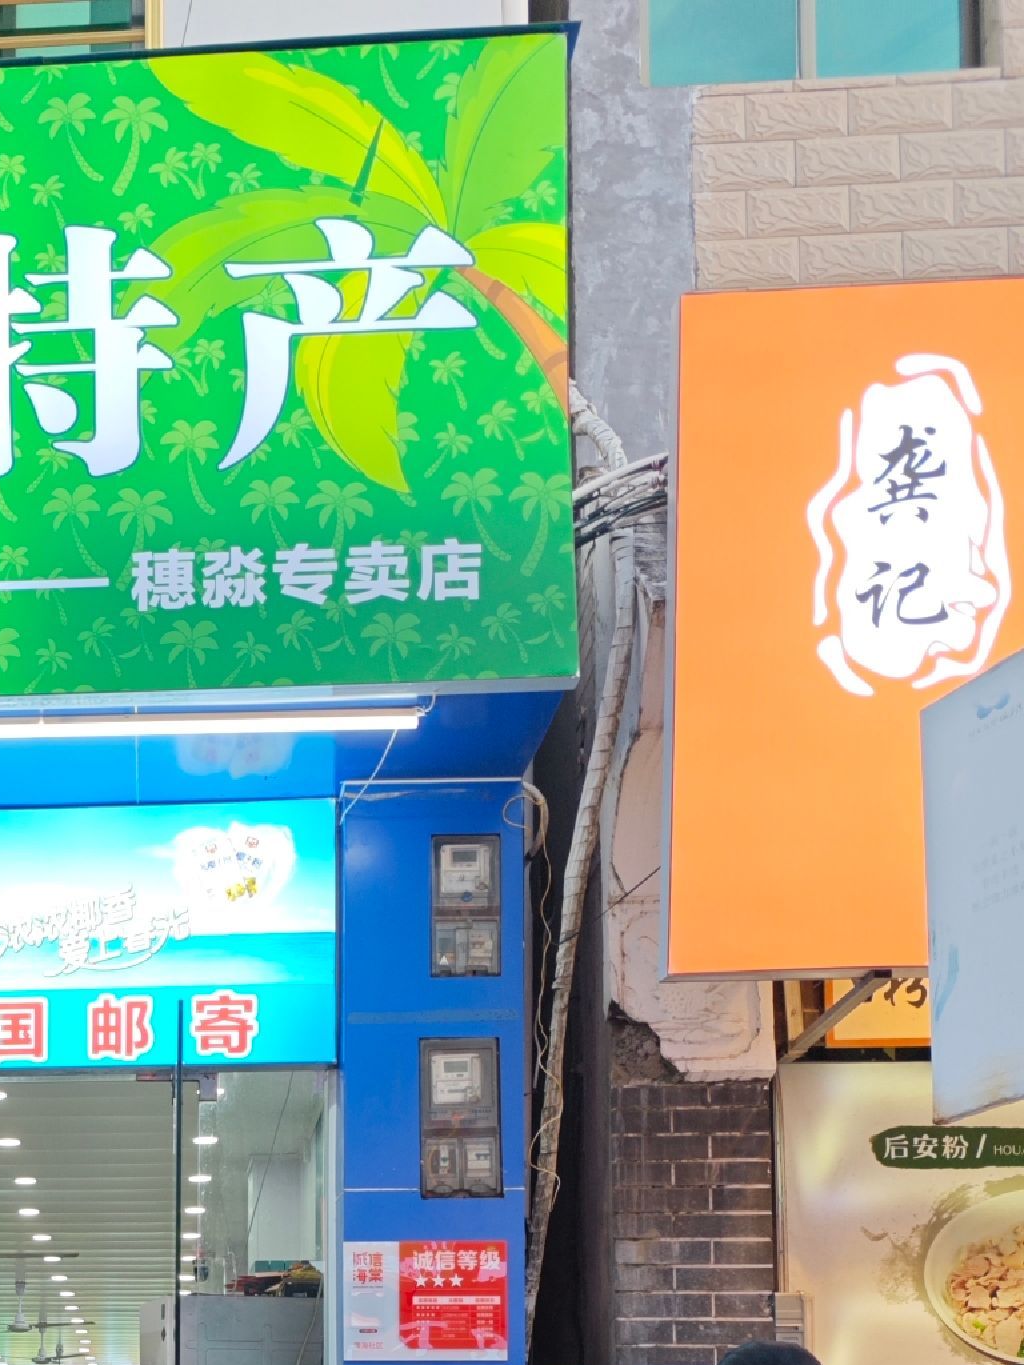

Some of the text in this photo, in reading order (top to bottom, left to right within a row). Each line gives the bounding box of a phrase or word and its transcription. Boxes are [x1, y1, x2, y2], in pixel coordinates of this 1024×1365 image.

[856, 424, 949, 628] 龚记
[131, 539, 483, 612] 穗淼专卖店
[883, 1133, 969, 1160] 后安粉
[412, 1250, 501, 1271] 诚信等级
